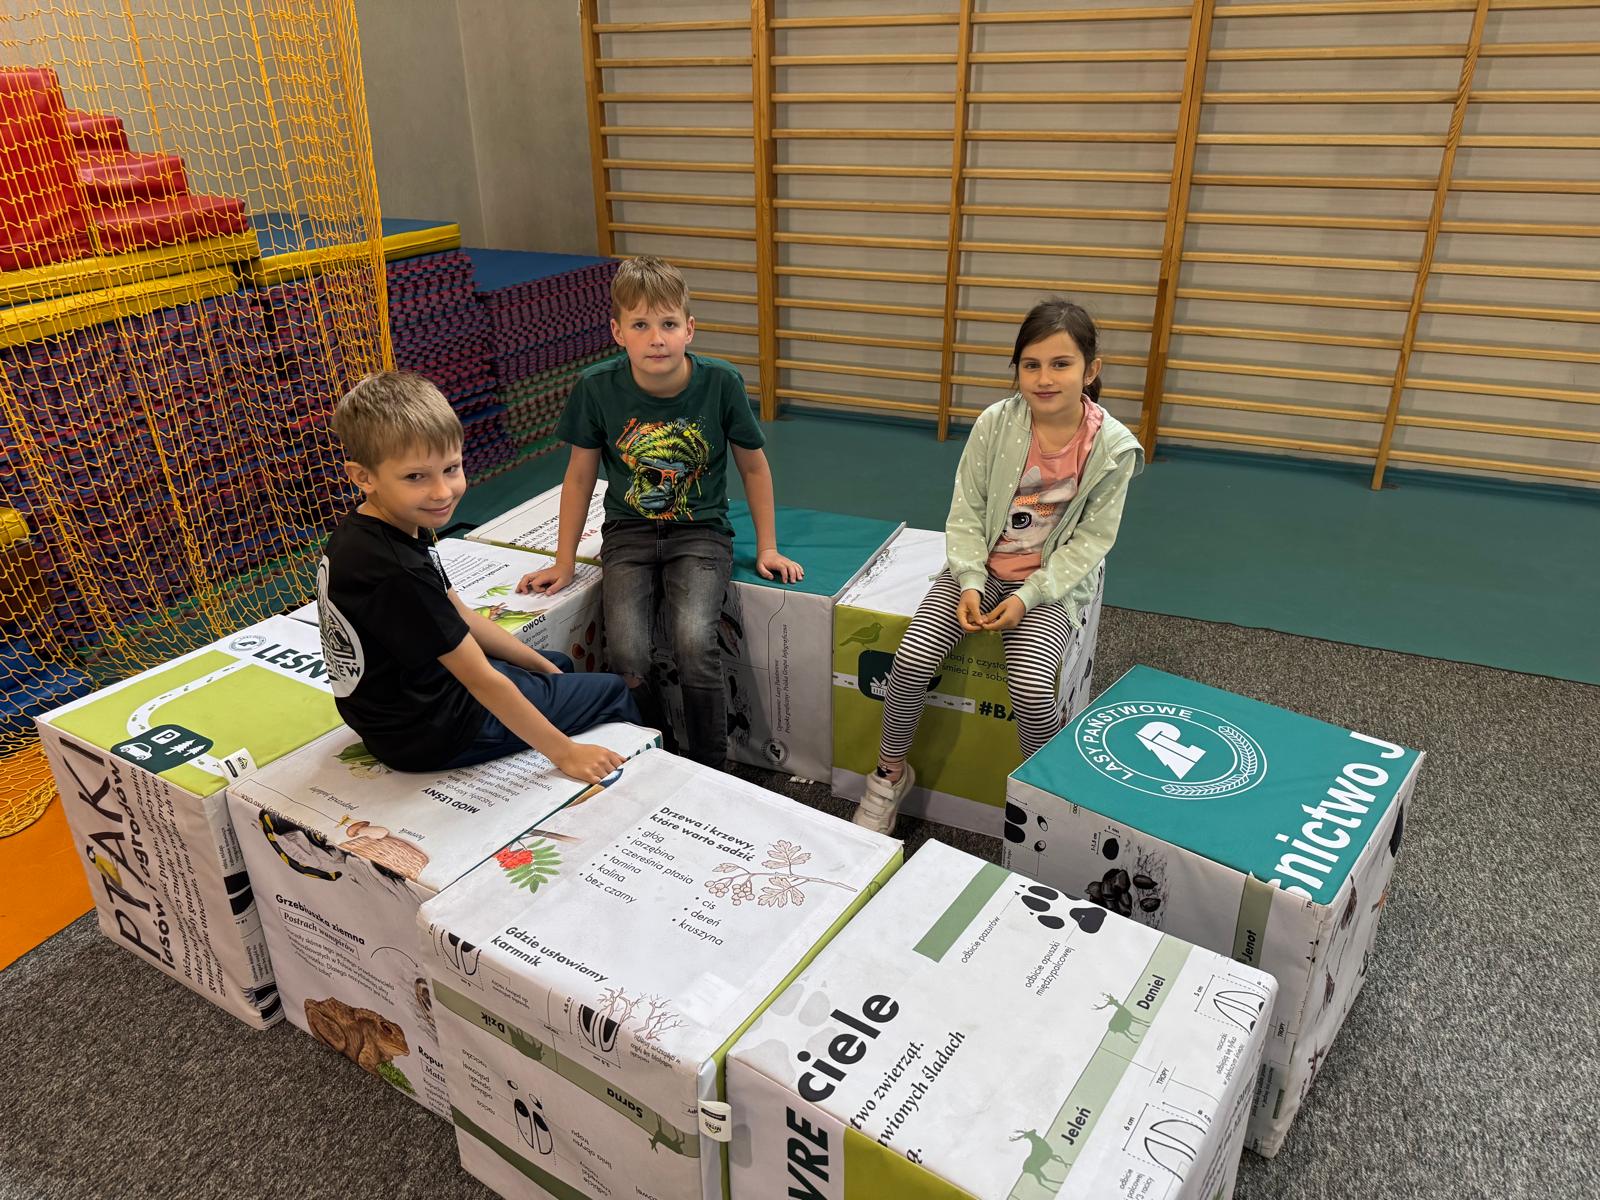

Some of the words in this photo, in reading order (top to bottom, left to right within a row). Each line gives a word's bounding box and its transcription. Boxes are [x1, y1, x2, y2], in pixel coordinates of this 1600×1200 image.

[523, 614, 546, 633] OWOCE
[252, 643, 330, 684] LEŚN
[972, 670, 983, 678] ze
[1083, 704, 1193, 744] PAŃSTWOWE
[1349, 731, 1405, 759] J
[1086, 746, 1134, 780] LASY
[421, 787, 451, 806] LEŚNY
[451, 800, 480, 814] MIÓD
[109, 759, 151, 878] ogrodów
[660, 807, 702, 828] Drzewa
[709, 827, 756, 851] krzewy,
[60, 737, 162, 962] PTAKI
[630, 838, 675, 861] jarzębina
[642, 829, 665, 843] głóg
[650, 814, 680, 830] które
[682, 828, 715, 846] warto
[716, 843, 755, 862] sadzić
[597, 864, 626, 882] kalina
[609, 856, 642, 874] tarnina
[621, 847, 664, 870] czereśnia
[663, 868, 694, 885] ptasia
[144, 881, 158, 892] i
[585, 873, 603, 889] bez
[604, 886, 637, 904] czarny
[276, 894, 330, 927] Grzebiuszka
[332, 922, 365, 945] ziemna
[690, 910, 722, 928] dereń
[702, 898, 717, 910] cis
[153, 895, 176, 970] lasów
[284, 912, 317, 933] Postrach
[678, 919, 724, 946] kruszyna
[491, 936, 542, 967] karmnik
[505, 927, 540, 949] Gdzie
[540, 947, 608, 983] ustawiamy
[961, 940, 981, 963] odbicie
[979, 916, 1000, 942] pazurów
[1242, 929, 1257, 962] Jenot
[1025, 964, 1044, 988] odbicie
[1042, 940, 1060, 965] opuszki
[1036, 946, 1075, 996] międzypalcowej
[1136, 974, 1166, 1010] Daniel
[481, 1011, 505, 1034] Dzik
[797, 994, 899, 1103] ciele
[922, 1031, 966, 1083] śladach
[849, 1099, 876, 1130] two
[874, 1041, 924, 1101] zwierząt.
[1156, 1067, 1170, 1085] TROPY
[607, 1087, 643, 1118] Sarna
[1061, 1106, 1091, 1146] Jeleń
[1127, 1116, 1135, 1127] cm
[1119, 1168, 1133, 1190] odbicie
